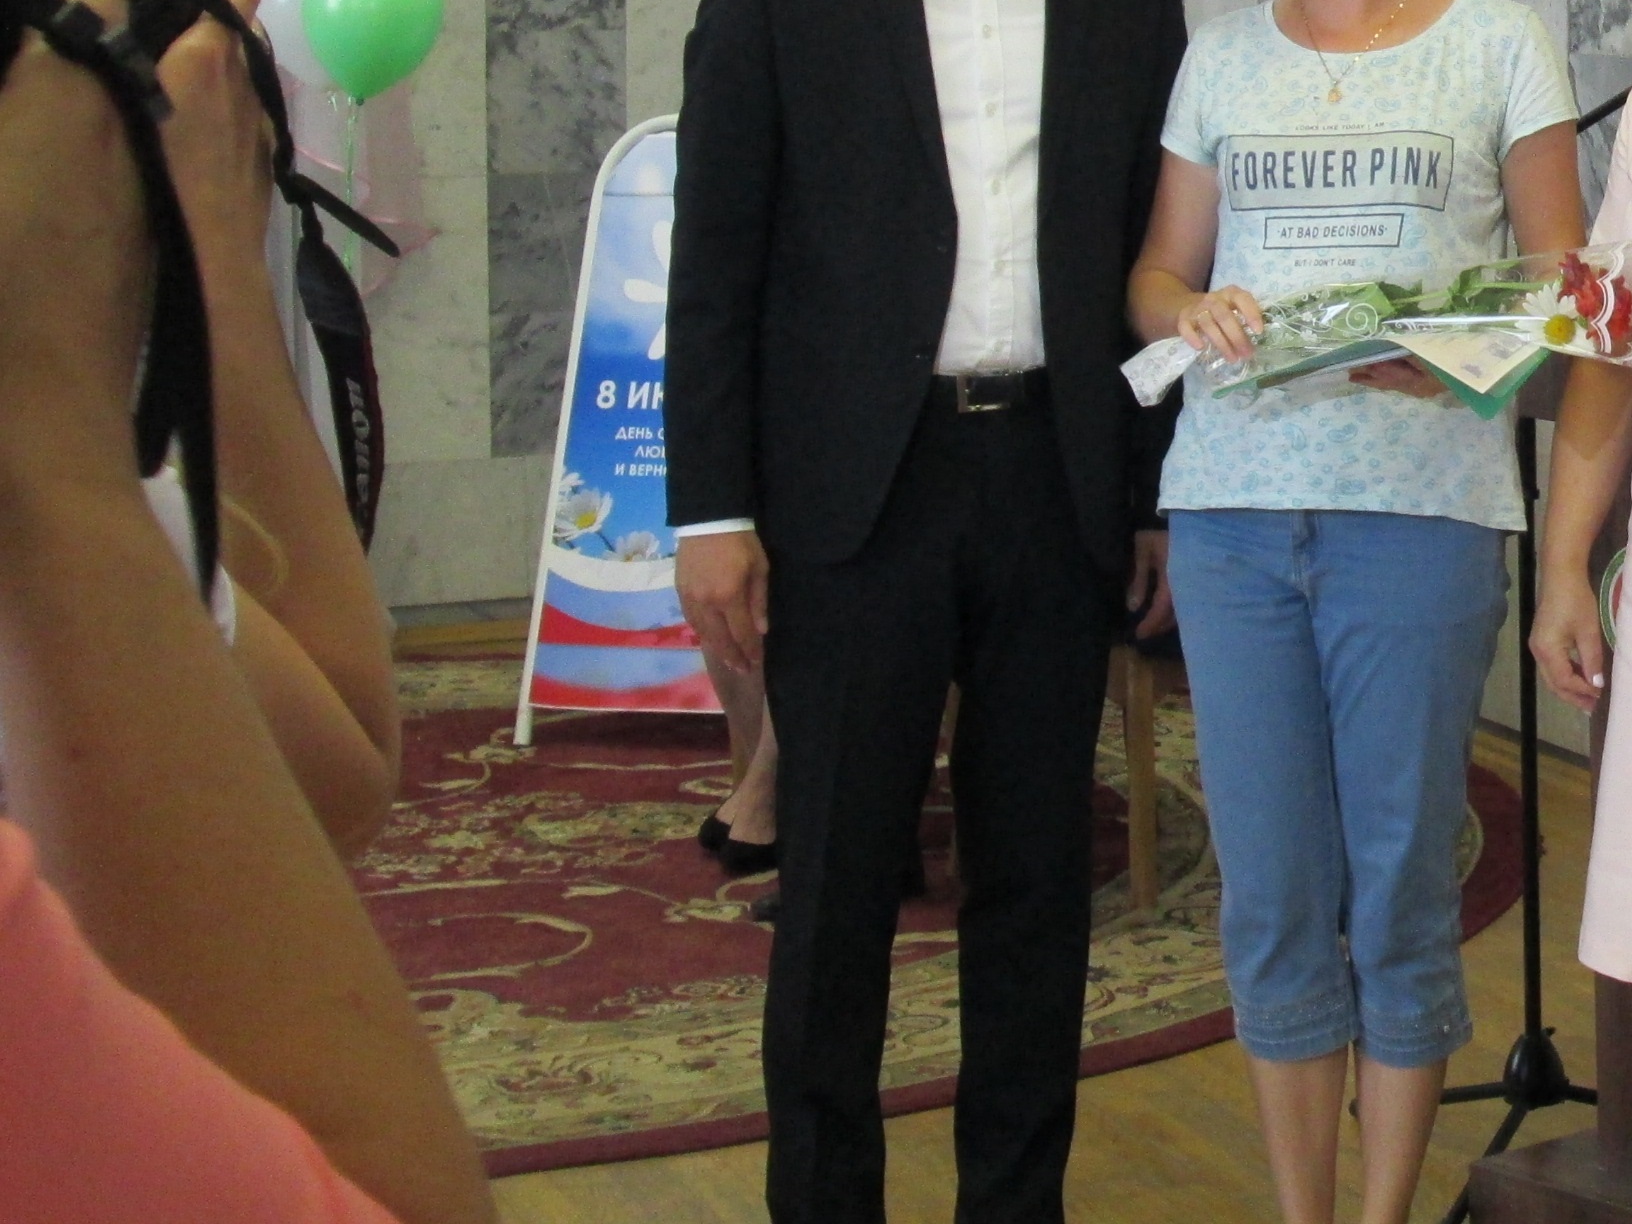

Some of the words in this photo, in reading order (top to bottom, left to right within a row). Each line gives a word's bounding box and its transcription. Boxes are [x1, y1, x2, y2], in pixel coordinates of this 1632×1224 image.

[1231, 150, 1357, 191] FOREVER
[1369, 146, 1442, 189] PINK
[1296, 226, 1319, 238] BAD
[1337, 258, 1357, 266] CARE
[597, 380, 616, 409] 8
[614, 426, 654, 441] ДЕНЬ
[634, 445, 666, 458] ЛЮ
[614, 463, 625, 476] И
[629, 463, 667, 476] ВЕРН
